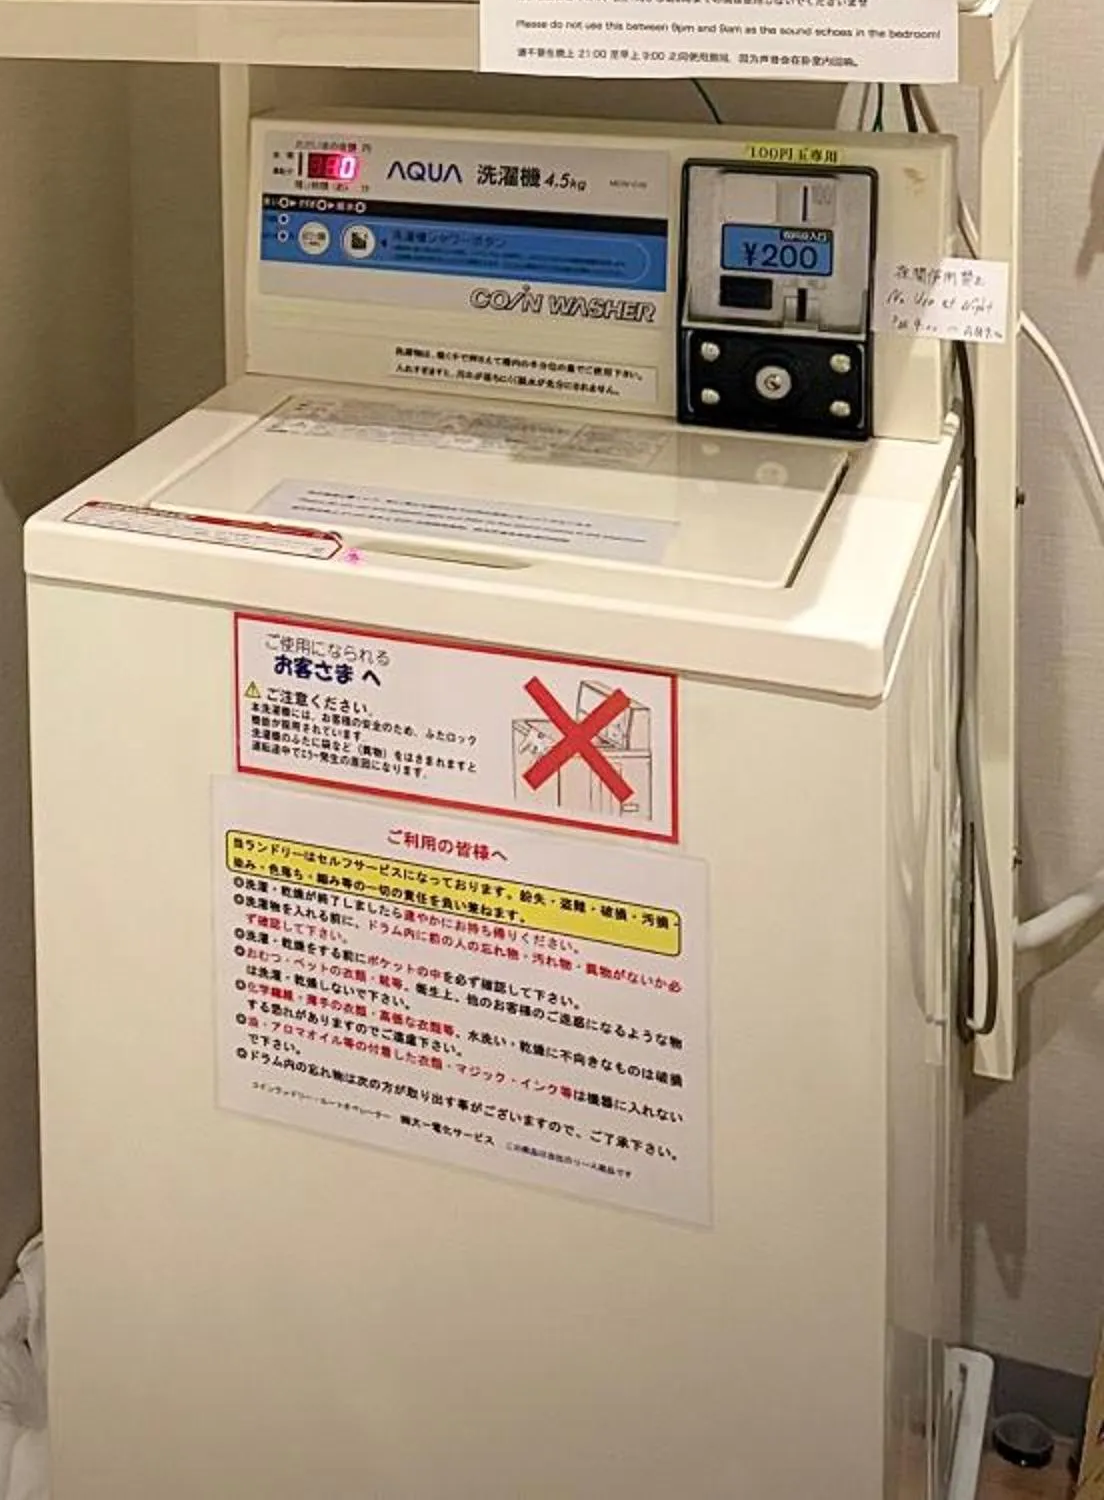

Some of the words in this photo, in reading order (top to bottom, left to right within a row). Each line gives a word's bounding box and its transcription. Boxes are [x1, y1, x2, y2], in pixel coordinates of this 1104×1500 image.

[516, 19, 547, 29] Please
[550, 20, 563, 29] do
[566, 21, 582, 30] not
[585, 23, 603, 31] use
[605, 21, 624, 31] this
[626, 23, 668, 32] between
[697, 24, 716, 33] and
[746, 26, 757, 35] as
[760, 26, 777, 35] the
[780, 27, 812, 36] sound
[815, 28, 853, 38] echoes
[856, 28, 865, 37] in
[868, 29, 885, 38] the
[339, 157, 356, 179] 0
[386, 161, 463, 185] AQUA
[477, 163, 541, 188] 洗濯機
[545, 173, 587, 192] 4.5kg
[743, 242, 818, 269] ¥200
[549, 295, 657, 324] WASHER
[265, 633, 391, 667] ご使用になられる
[387, 827, 508, 862] ご利用の皆様へ
